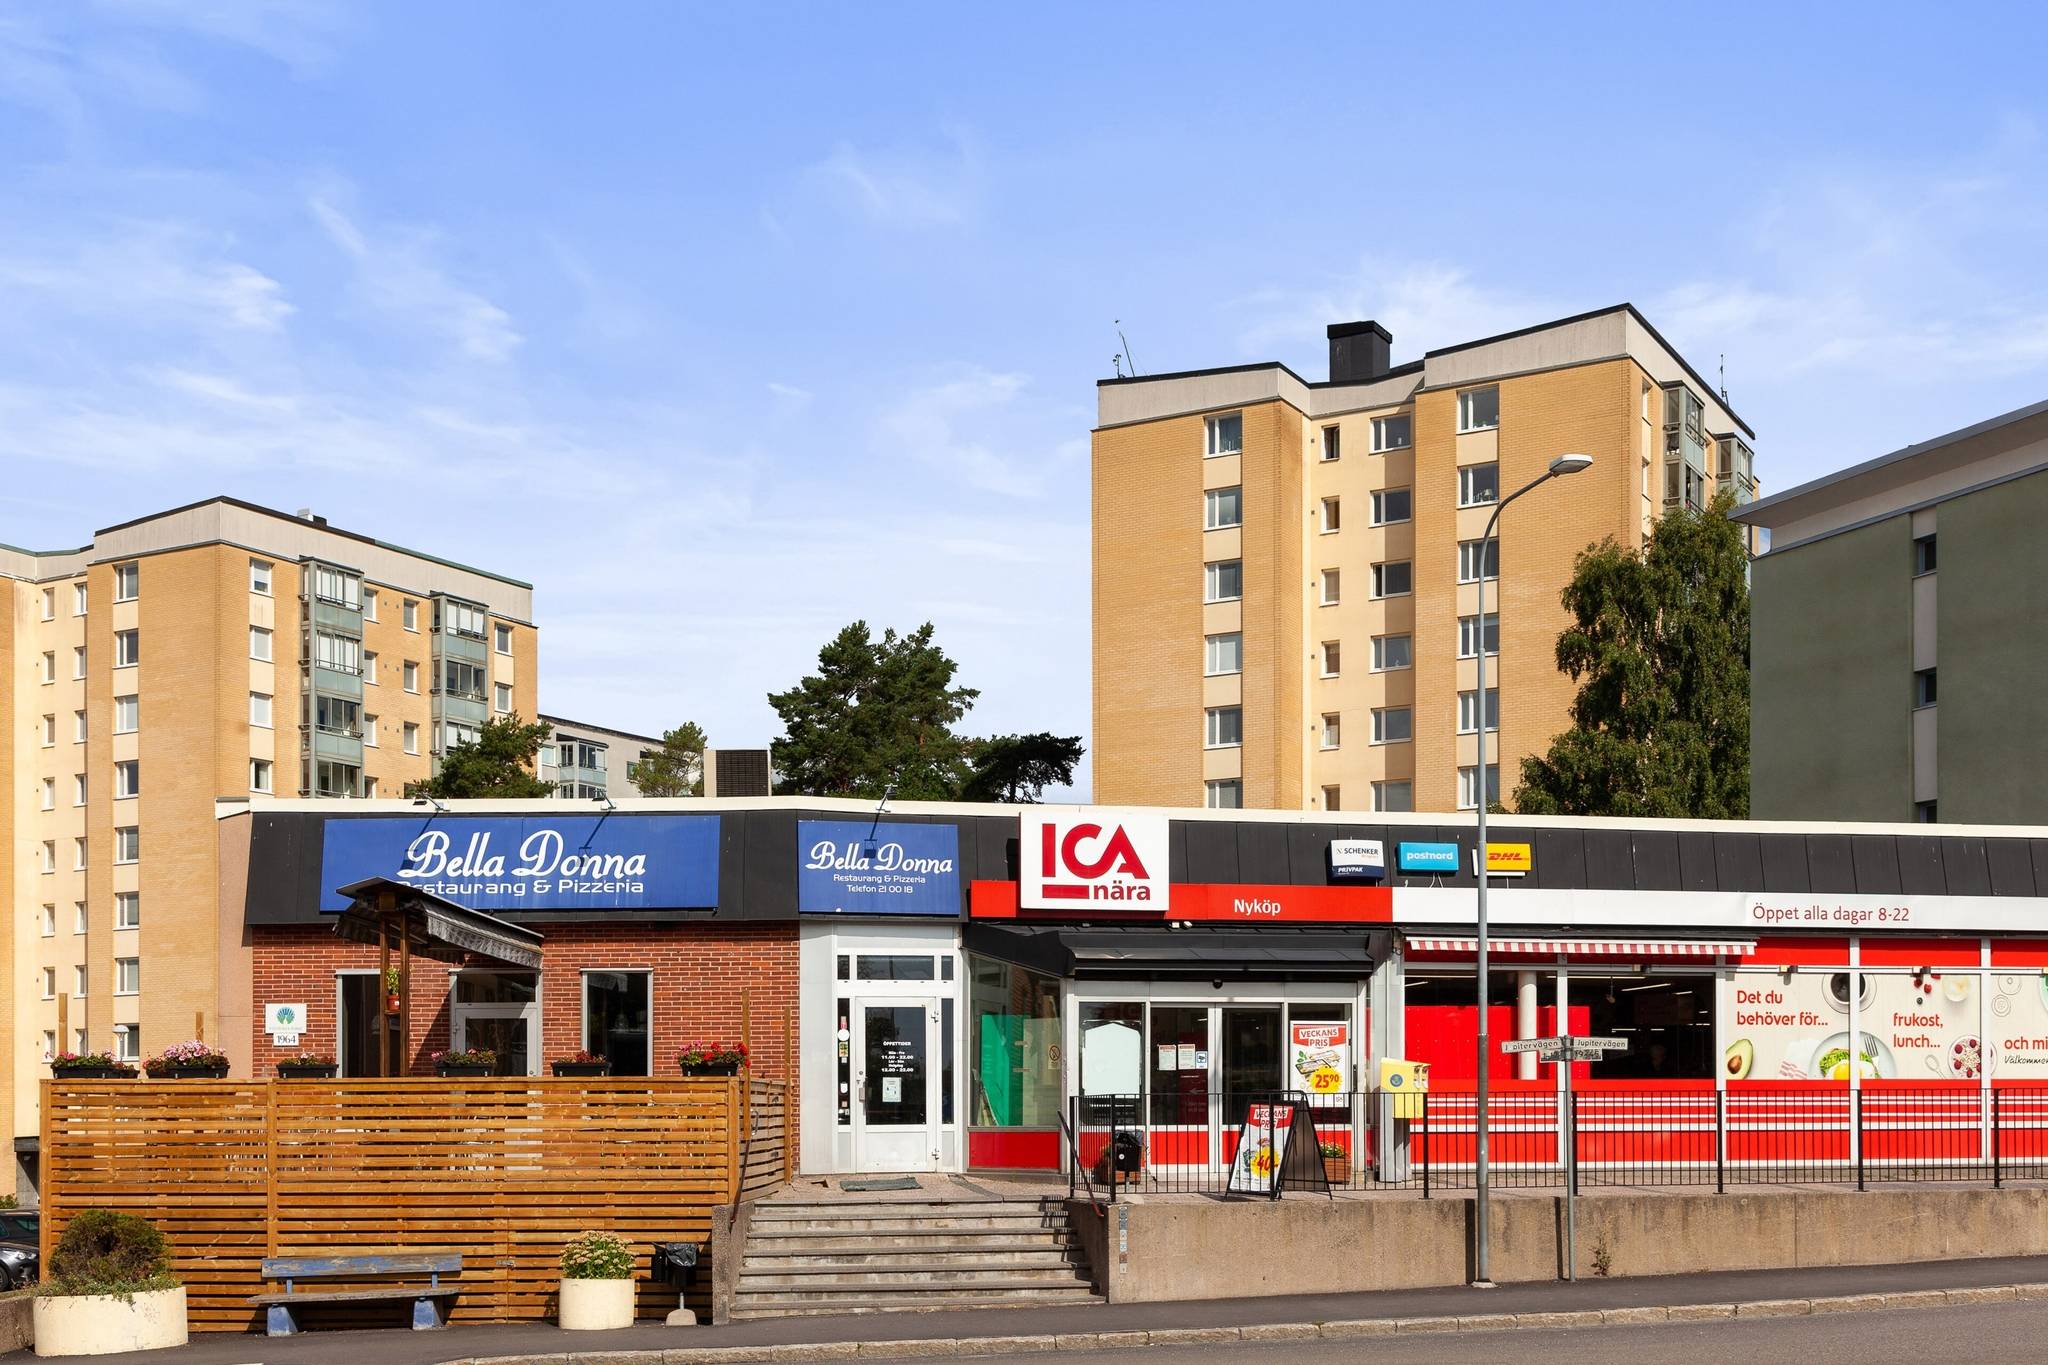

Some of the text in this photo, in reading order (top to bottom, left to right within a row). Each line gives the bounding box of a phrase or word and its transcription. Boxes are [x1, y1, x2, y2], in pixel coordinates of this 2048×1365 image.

[397, 829, 646, 879] Bella Donna
[805, 840, 952, 874] Bella Donna
[1041, 823, 1150, 879] ICA
[1344, 847, 1378, 855] SCHENKER
[1407, 852, 1454, 861] postnord
[1488, 852, 1523, 861] DHL
[833, 874, 926, 883] Restaurang & Pizzeria
[533, 879, 552, 894] &
[558, 879, 645, 894] Pizzeria
[846, 884, 913, 893] Telefon 21 00 18
[1093, 880, 1150, 901] nära
[1234, 899, 1281, 915] Nyköp
[1753, 902, 1910, 925] Öppet alla dagar 8-22
[1737, 990, 1783, 1005] Det du
[1737, 1011, 1828, 1026] behöver för...
[1893, 1012, 1944, 1029] frukost,
[277, 1035, 296, 1044] 1964
[1301, 1029, 1337, 1038] VECKANS
[1309, 1039, 1328, 1047] PRIS
[1505, 1041, 1558, 1051] Jpitervägen
[1578, 1039, 1626, 1049] Jupitervägen
[1893, 1034, 1941, 1049] lunch...
[2004, 1036, 2029, 1050] och
